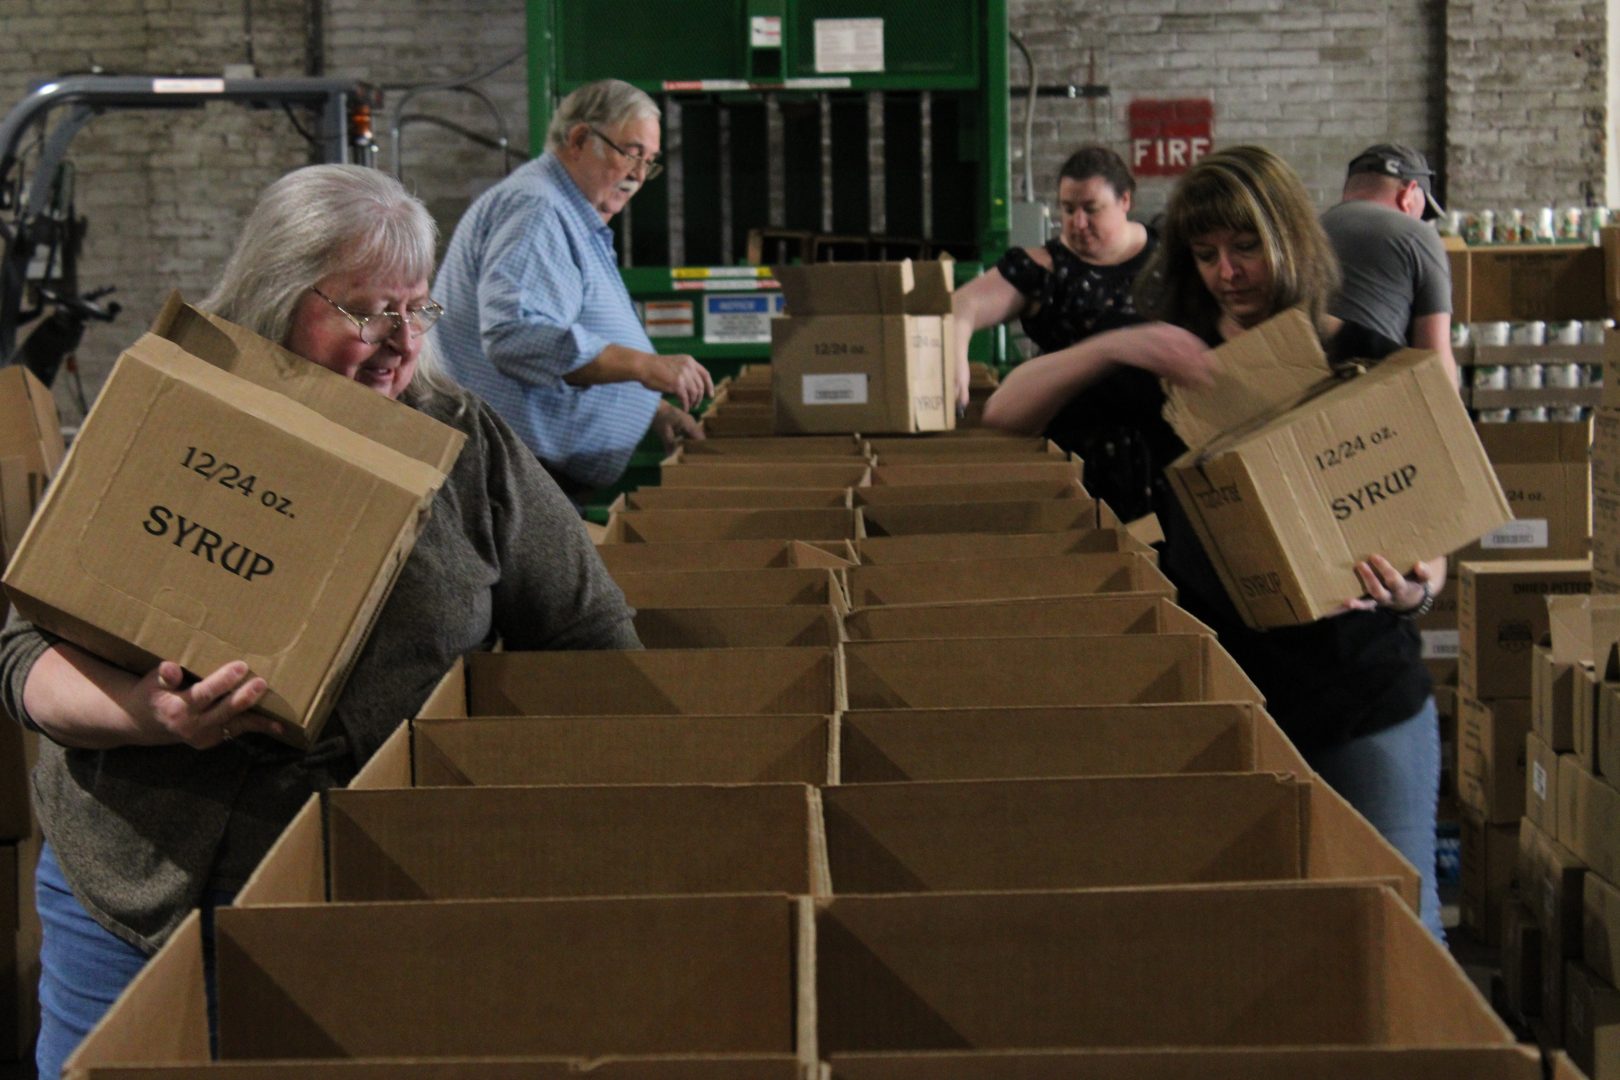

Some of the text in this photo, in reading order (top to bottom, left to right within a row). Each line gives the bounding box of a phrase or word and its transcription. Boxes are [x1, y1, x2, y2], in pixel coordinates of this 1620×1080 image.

[1314, 426, 1399, 472] 12/24 oz.
[179, 445, 297, 520] 12/24 oz.
[1331, 463, 1419, 521] SYRUP
[142, 504, 276, 583] SYRUP
[1239, 572, 1282, 597] SYRUP
